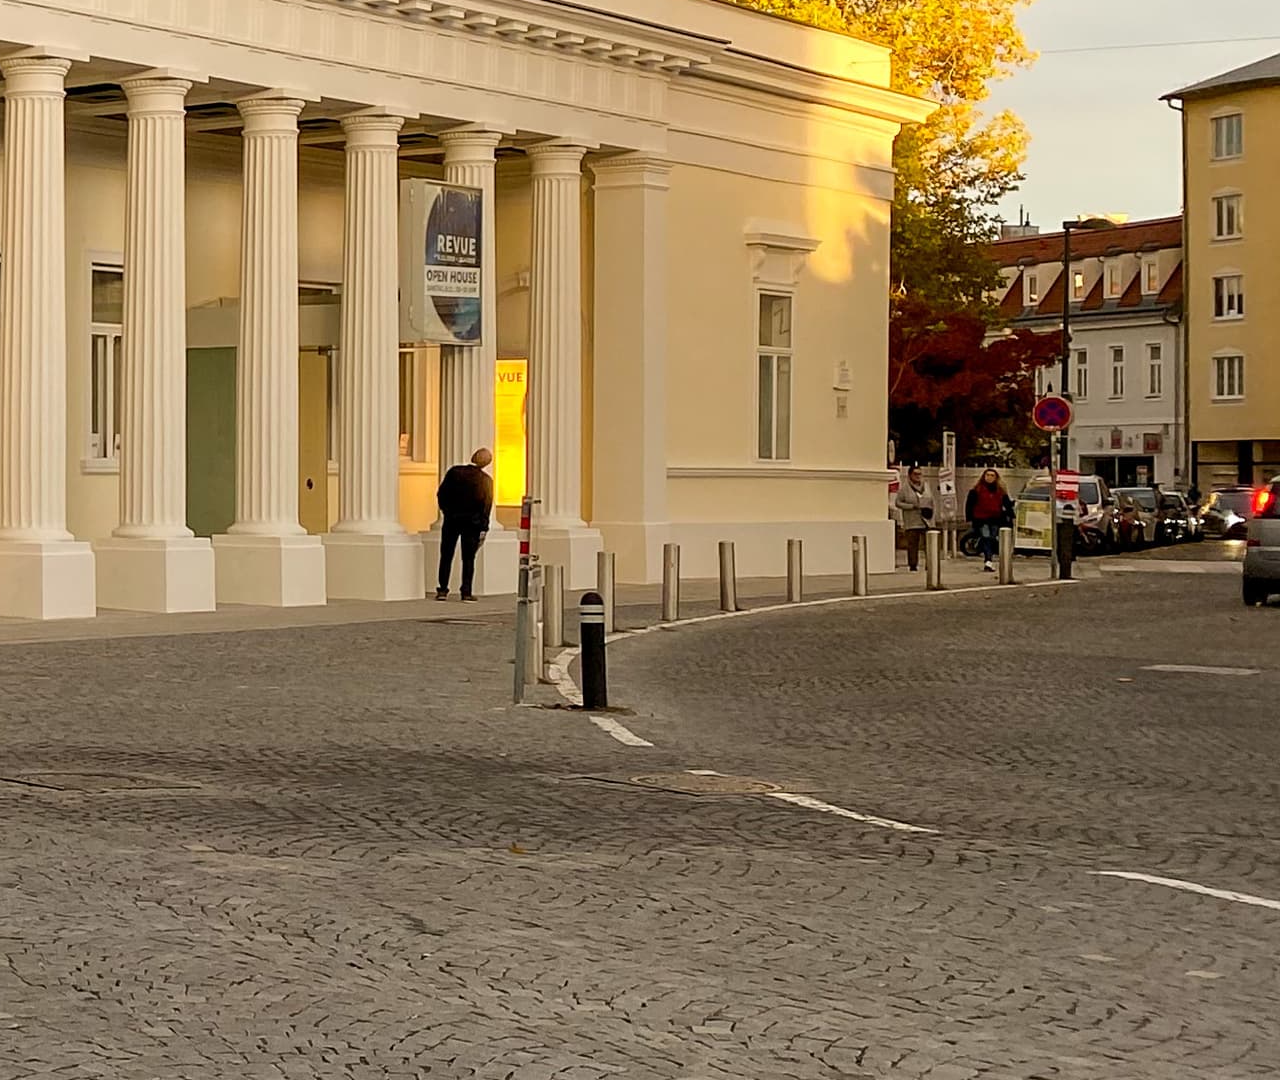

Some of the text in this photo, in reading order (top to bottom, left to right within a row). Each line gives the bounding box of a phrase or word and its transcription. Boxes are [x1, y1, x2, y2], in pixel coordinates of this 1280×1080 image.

[437, 234, 476, 256] REVUE
[426, 270, 478, 284] OPEN HOUSE
[498, 372, 524, 383] VUE
